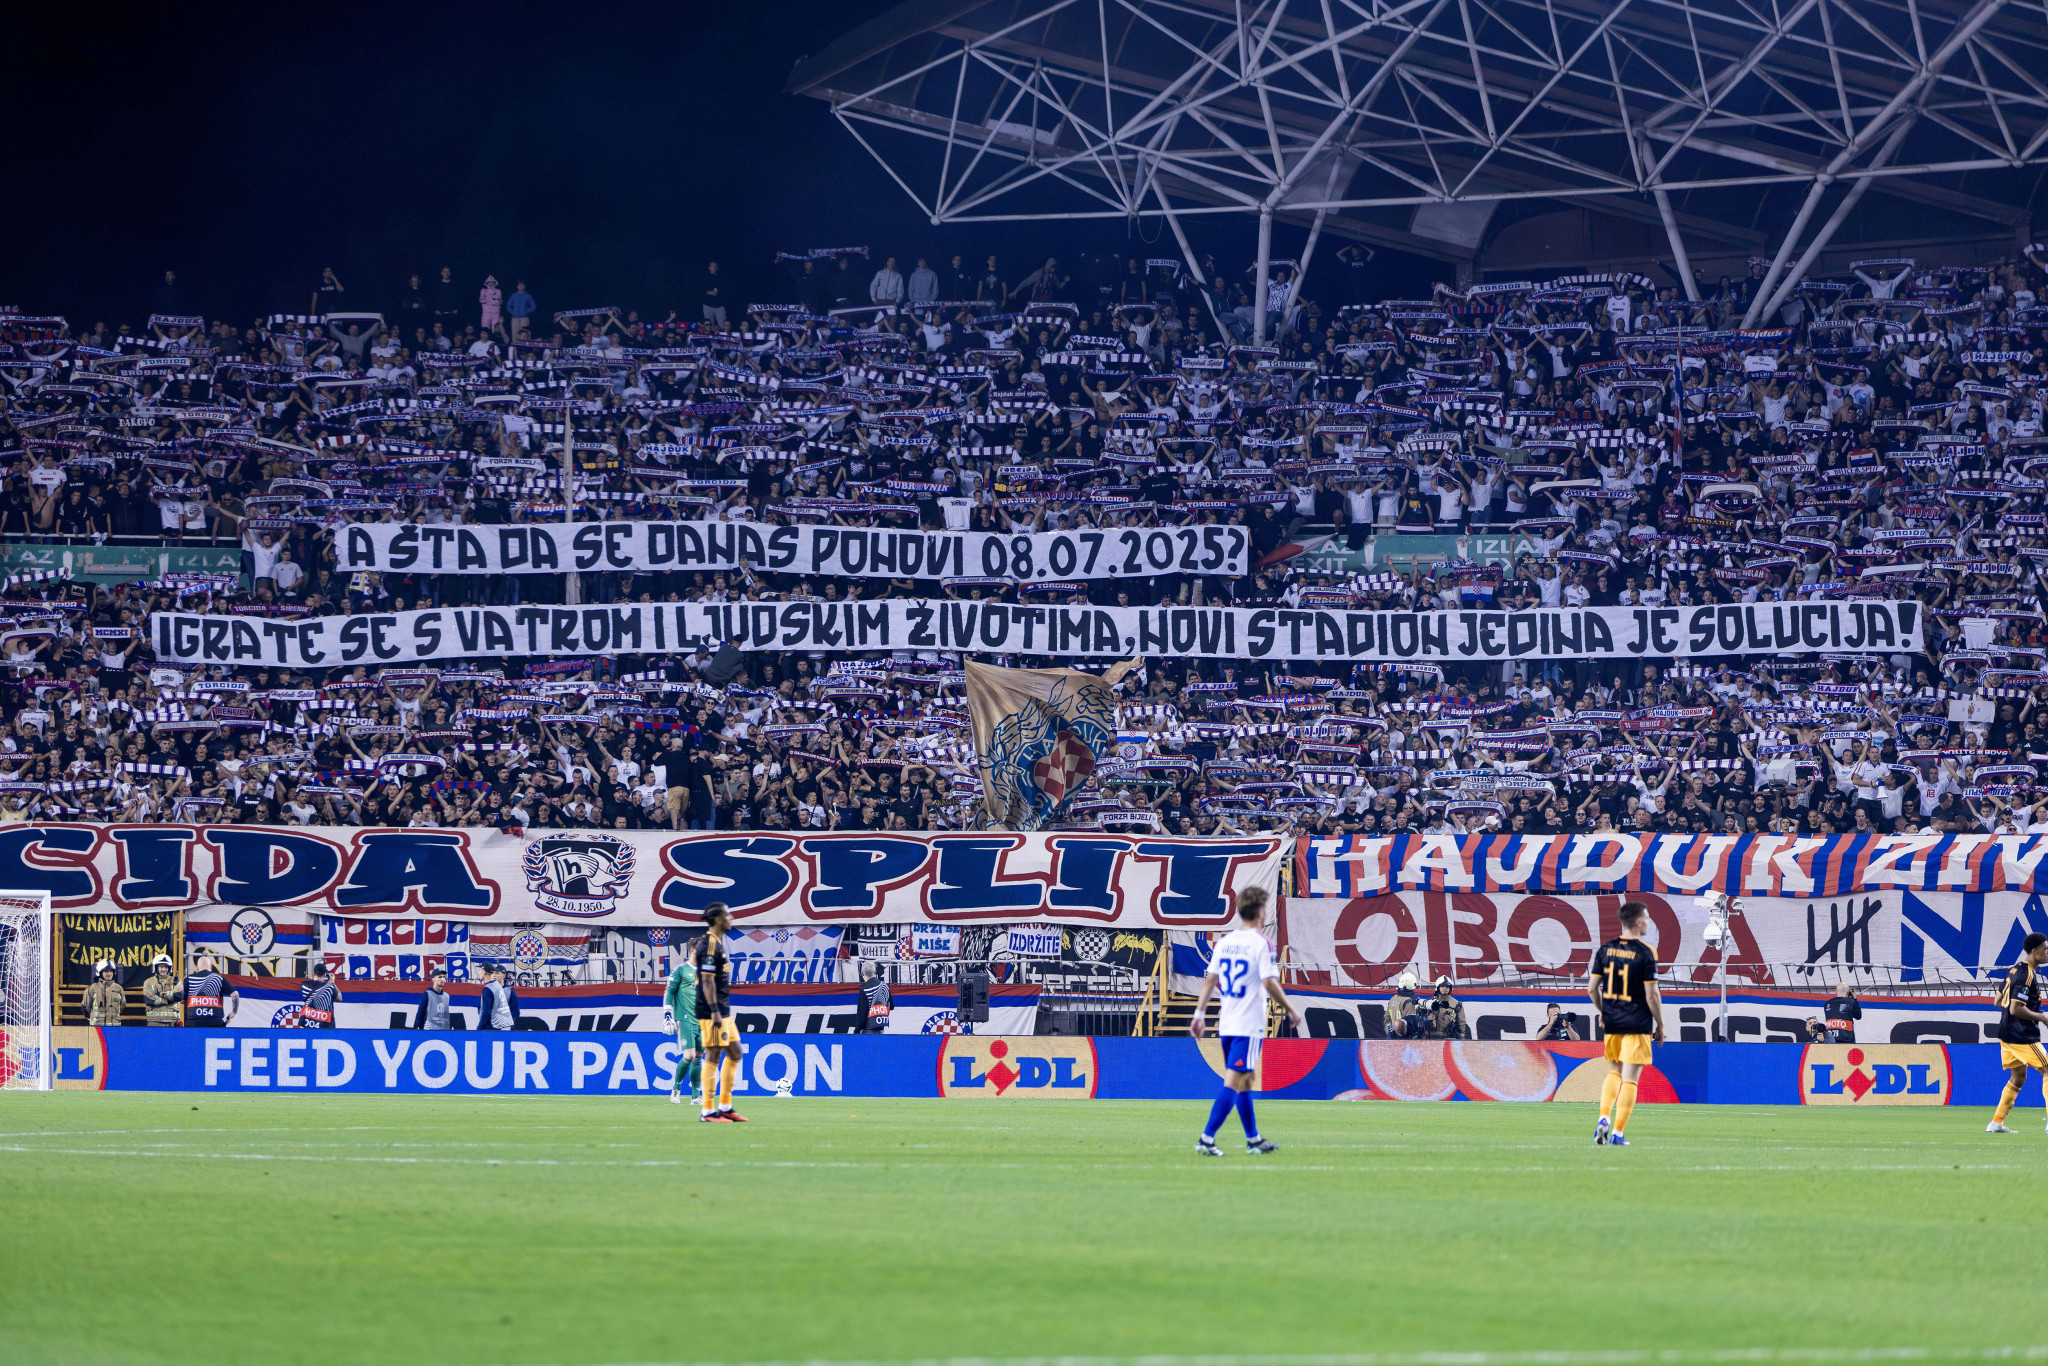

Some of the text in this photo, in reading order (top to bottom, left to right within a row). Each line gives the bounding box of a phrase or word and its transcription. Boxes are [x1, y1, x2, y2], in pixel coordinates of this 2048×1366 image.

[1480, 284, 1521, 292] TORCIDA
[153, 316, 200, 325] HAJDUK
[1410, 333, 1439, 344] FORZA
[1740, 330, 1782, 338] hajduk
[1071, 336, 1118, 345] HAJDUK
[1184, 358, 1223, 366] Hajduk Split
[1381, 404, 1418, 416] TORCIDA
[182, 412, 225, 420] TORCIDA
[885, 436, 930, 445] HAJDUK
[646, 444, 690, 453] HAJDUK
[1904, 458, 1950, 466] HAJDUK
[1610, 491, 1636, 499] BOYS
[1904, 508, 1941, 519] HAJDUK
[349, 524, 1244, 579] A ŠTA DA SE DANAS PONOVI 08.07.2025?
[1966, 563, 2012, 573] HAJDUK
[96, 629, 128, 637] MCMXI
[159, 600, 1918, 664] IGRATE SE S VATROM I LJUDSKIM ŽIVOTIMA, NOVI STADION JEDINA JE SOLUCIJA!
[841, 660, 885, 670] HAJDUK
[198, 682, 245, 690] TORCIDA
[508, 694, 552, 703] TORCIDA
[1310, 833, 1815, 893] HAJDUK
[652, 833, 1281, 926] SPLIT
[546, 896, 604, 912] 28.10.1950.
[322, 915, 468, 945] TORCIDA
[918, 937, 950, 951] MIŠE
[1009, 933, 1060, 954] IZDRŽITE
[68, 942, 168, 968] ZABRANOM
[1080, 952, 1102, 960] SPLIT
[323, 952, 470, 980] ZAGREB
[1218, 958, 1248, 998] 32
[1603, 962, 1632, 1002] 11
[191, 997, 218, 1006] PHOTO
[196, 1008, 214, 1016] 054
[305, 1008, 328, 1020] HOTO
[205, 1038, 842, 1092] FEED YOUR PASION
